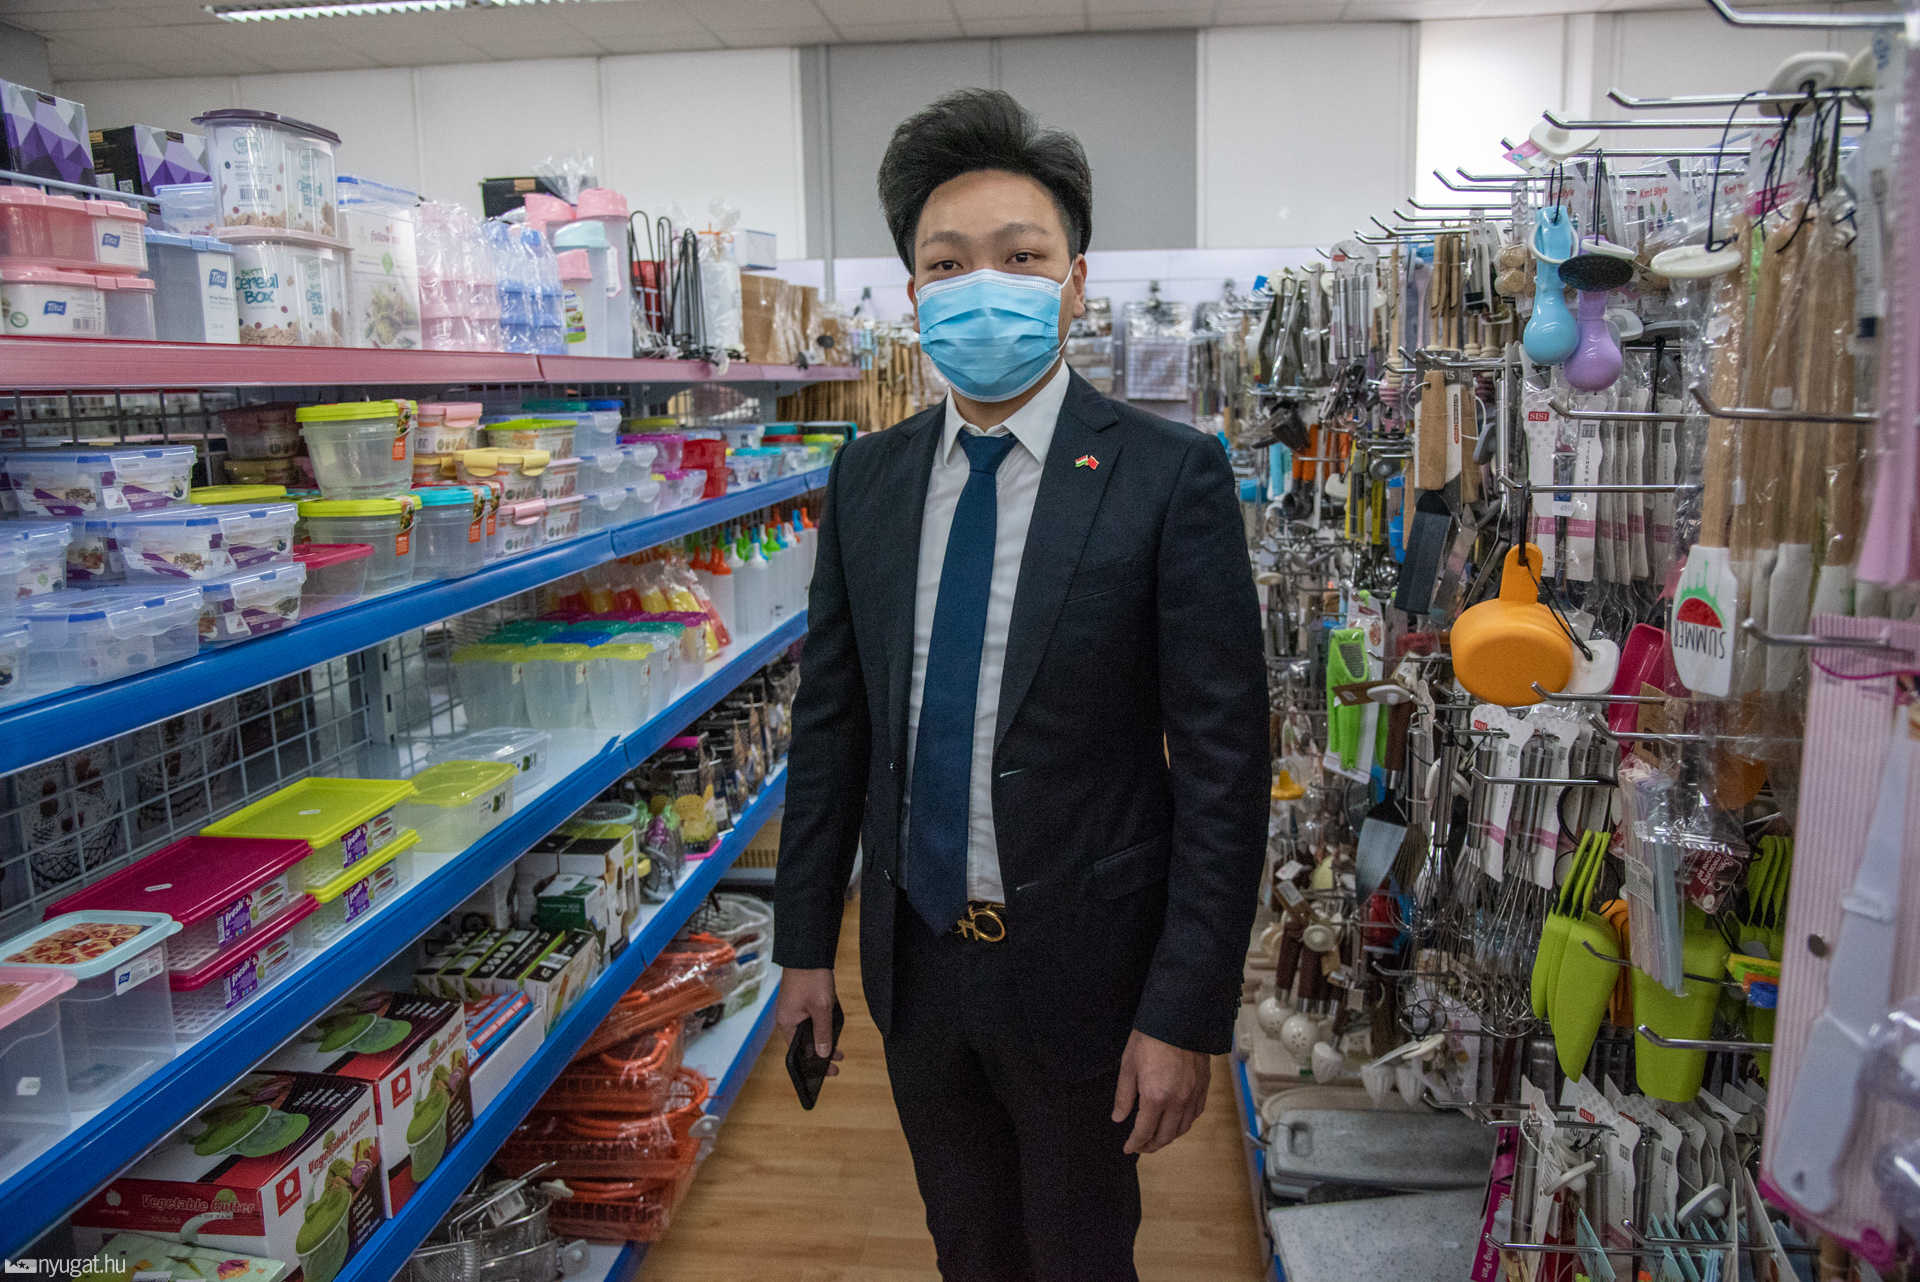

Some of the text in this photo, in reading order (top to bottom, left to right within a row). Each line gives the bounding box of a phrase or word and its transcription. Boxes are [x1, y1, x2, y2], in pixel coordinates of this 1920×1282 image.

[1529, 412, 1549, 421] SISI
[1674, 621, 1726, 659] SUMMER
[308, 1128, 349, 1175] Vegetable
[141, 1193, 209, 1211] Vegetable
